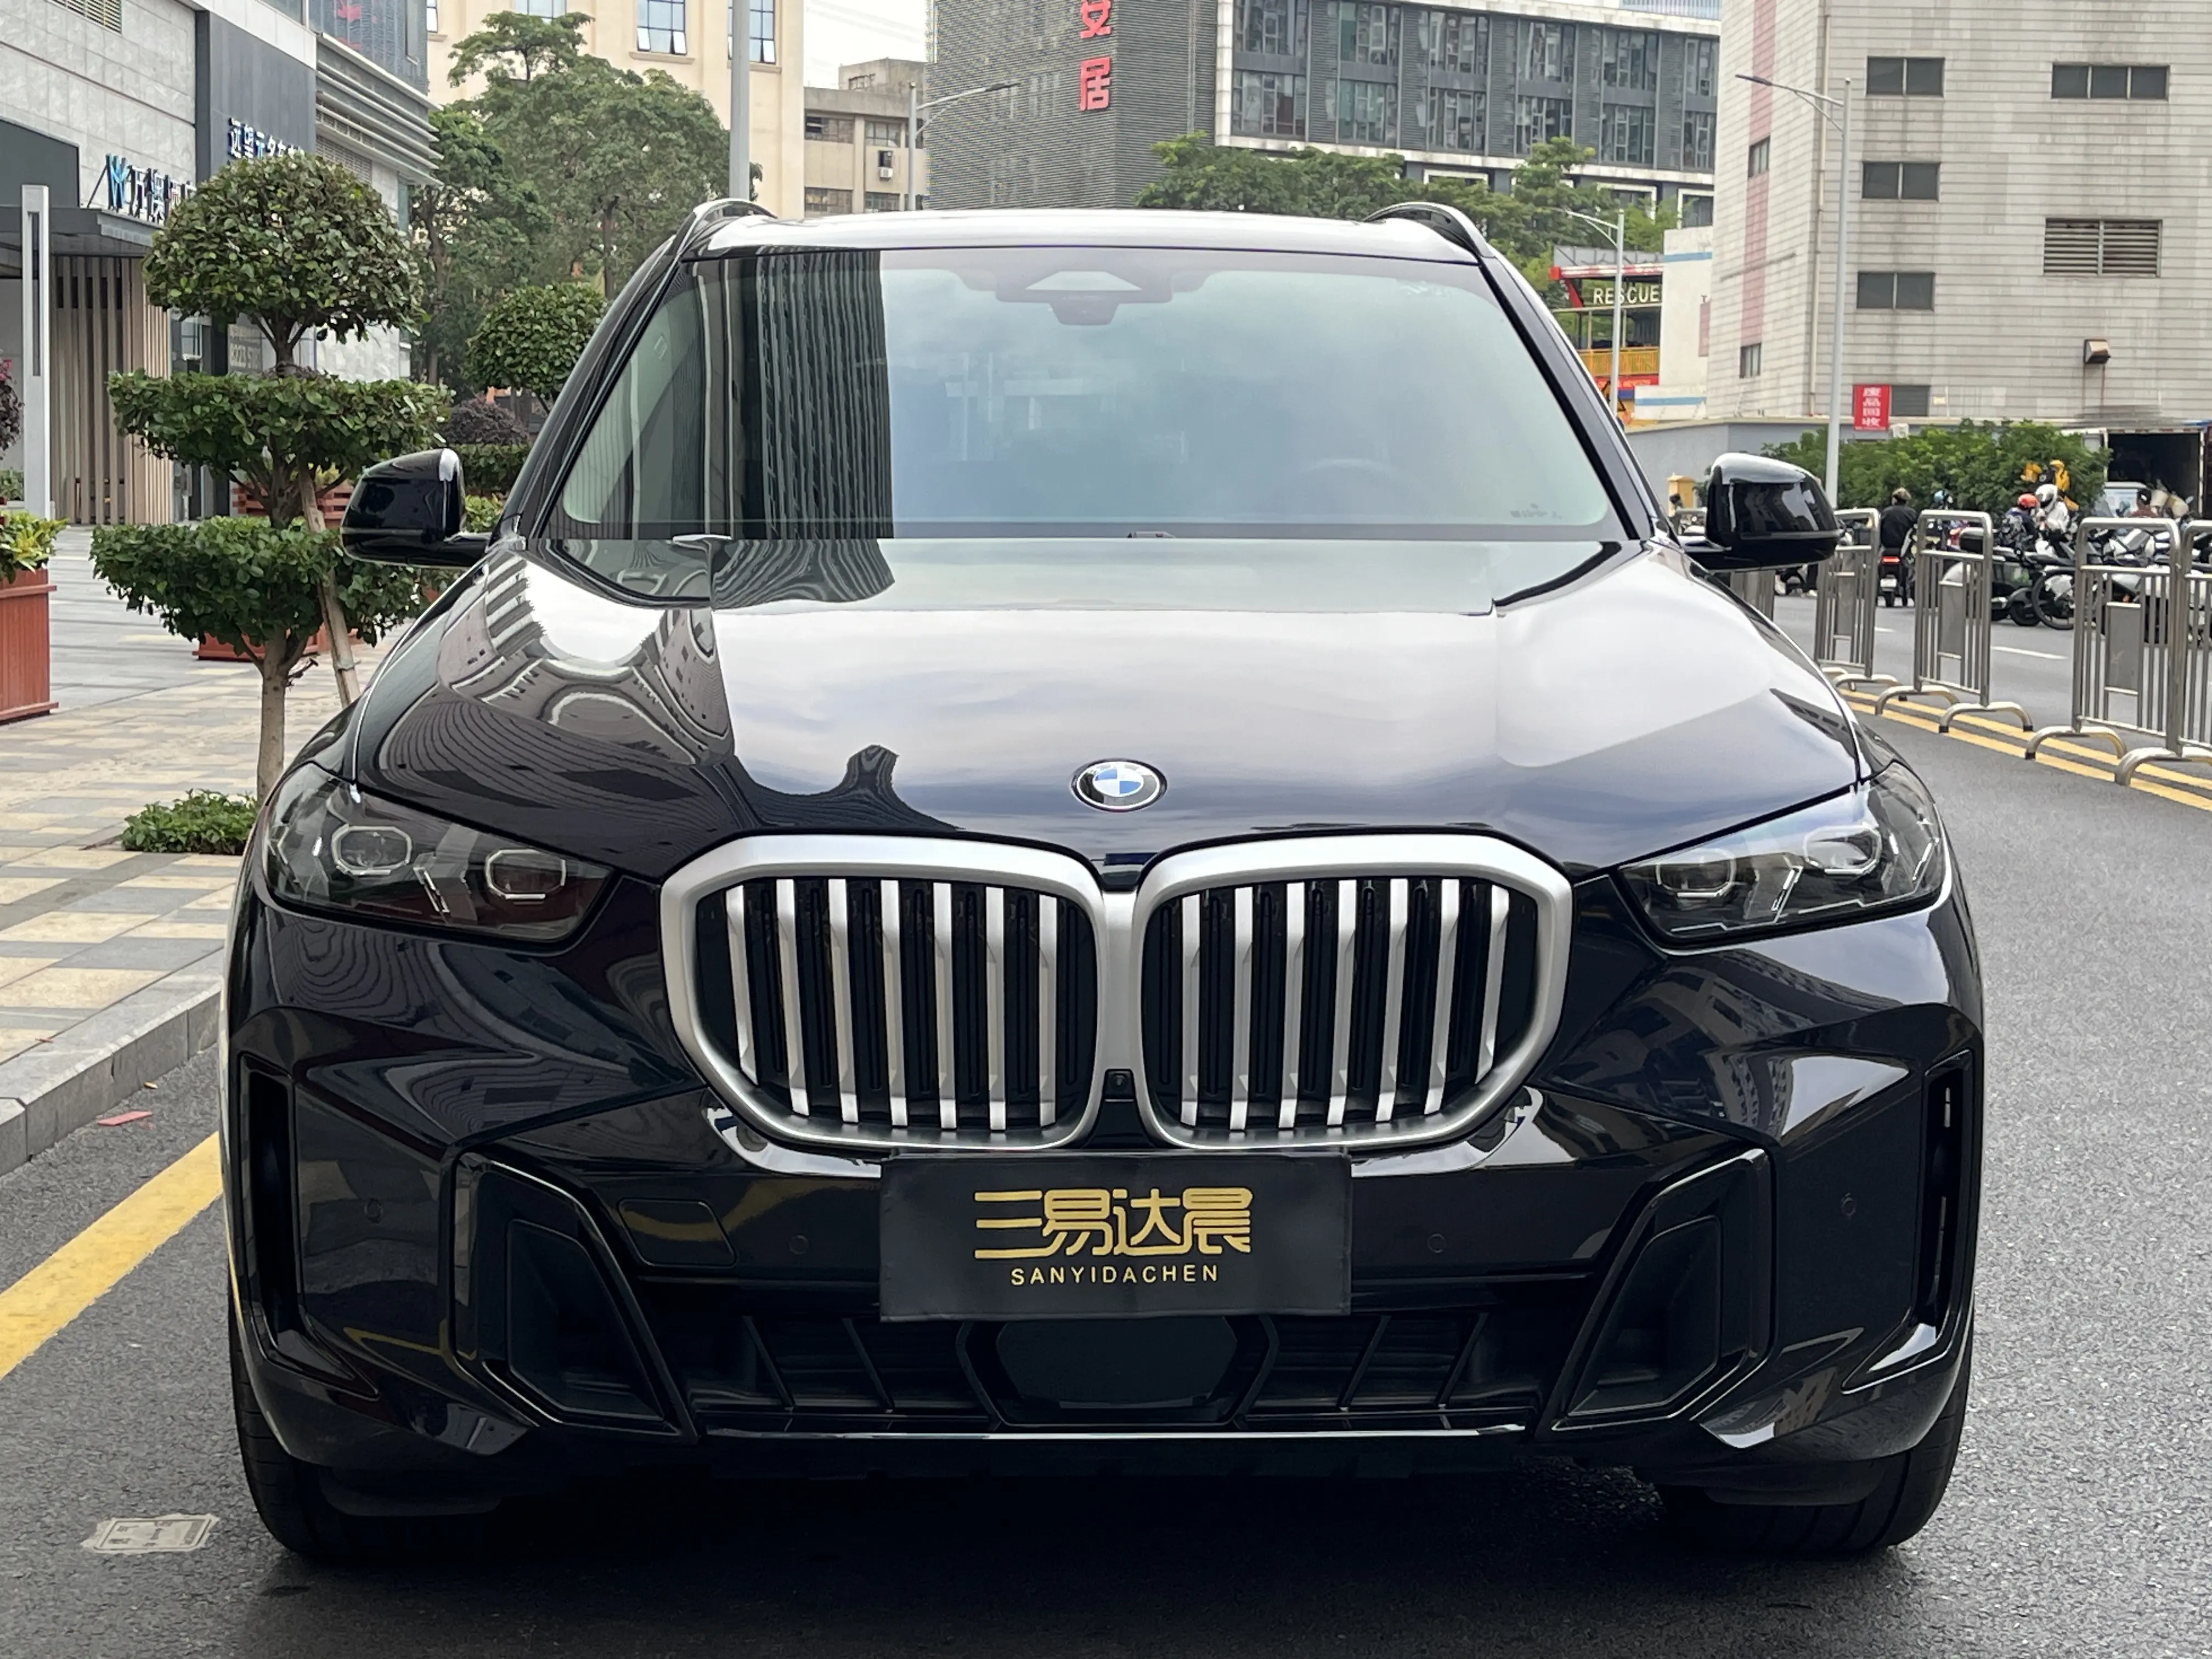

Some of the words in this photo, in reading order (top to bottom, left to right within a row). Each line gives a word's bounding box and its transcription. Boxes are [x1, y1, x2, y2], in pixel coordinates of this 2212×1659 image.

[973, 1187, 1254, 1260] 三易达晨
[1011, 1265, 1220, 1286] SANYIDACHEN
